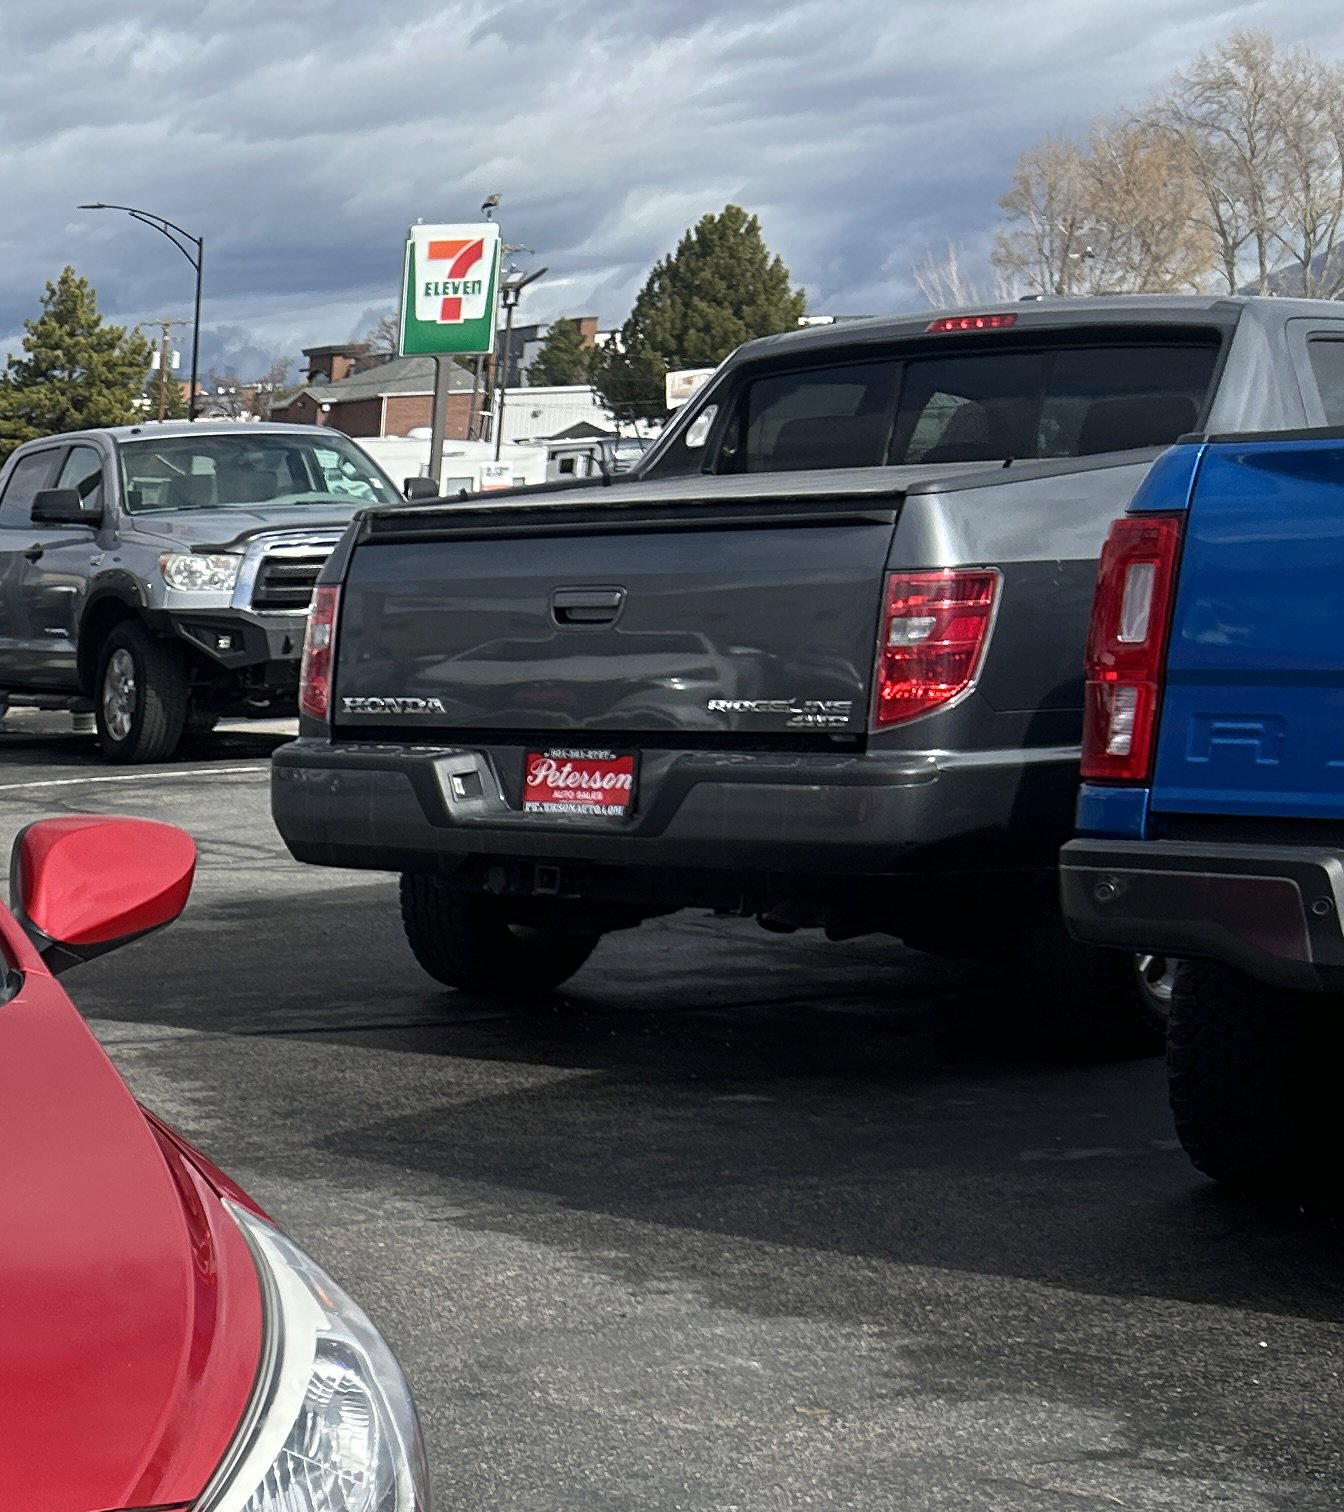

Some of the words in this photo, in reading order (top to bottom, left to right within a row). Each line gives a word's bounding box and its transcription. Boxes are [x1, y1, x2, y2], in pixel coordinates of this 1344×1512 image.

[428, 237, 484, 320] 7
[342, 697, 447, 714] HONDA
[526, 758, 633, 790] Peterson
[552, 789, 576, 799] AUTO
[575, 790, 604, 801] SALES
